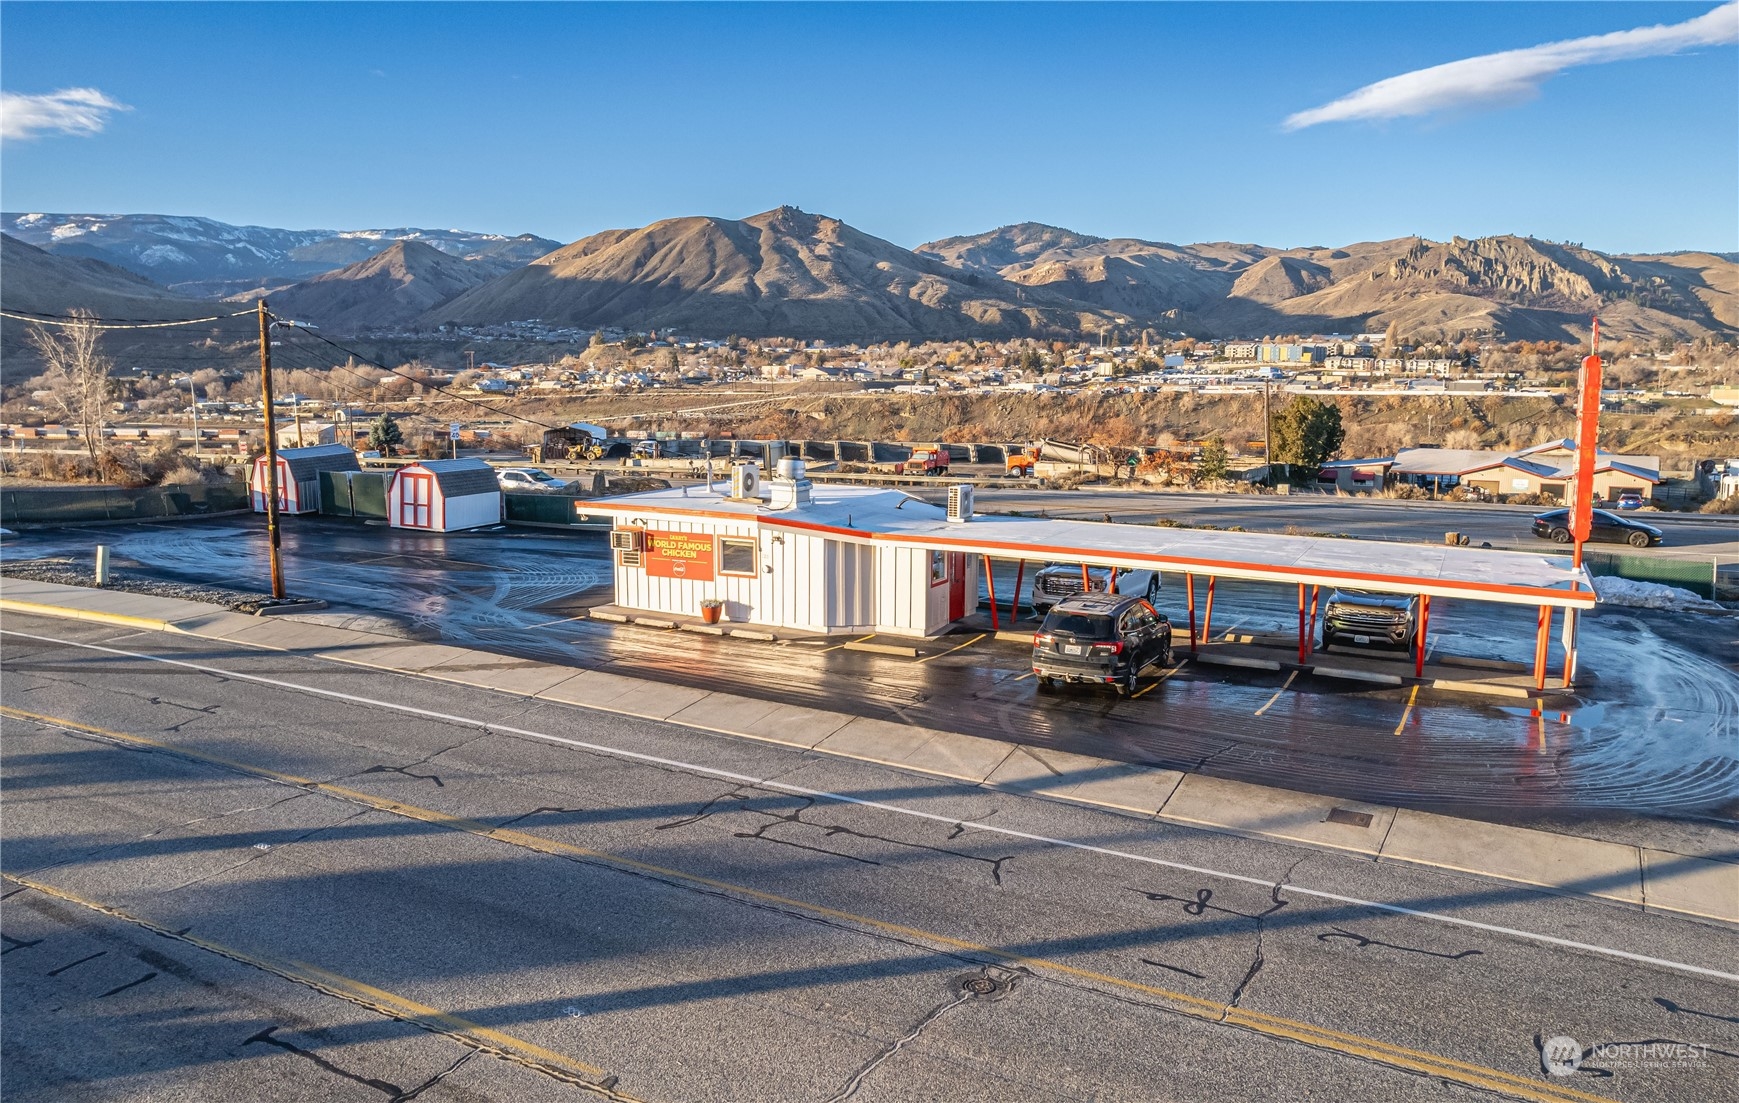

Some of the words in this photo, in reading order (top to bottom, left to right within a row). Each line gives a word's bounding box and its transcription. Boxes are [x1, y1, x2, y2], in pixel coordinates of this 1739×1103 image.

[648, 539, 676, 549] WORLD
[678, 542, 712, 551] FAMOUS
[662, 549, 697, 558] CHICKEN
